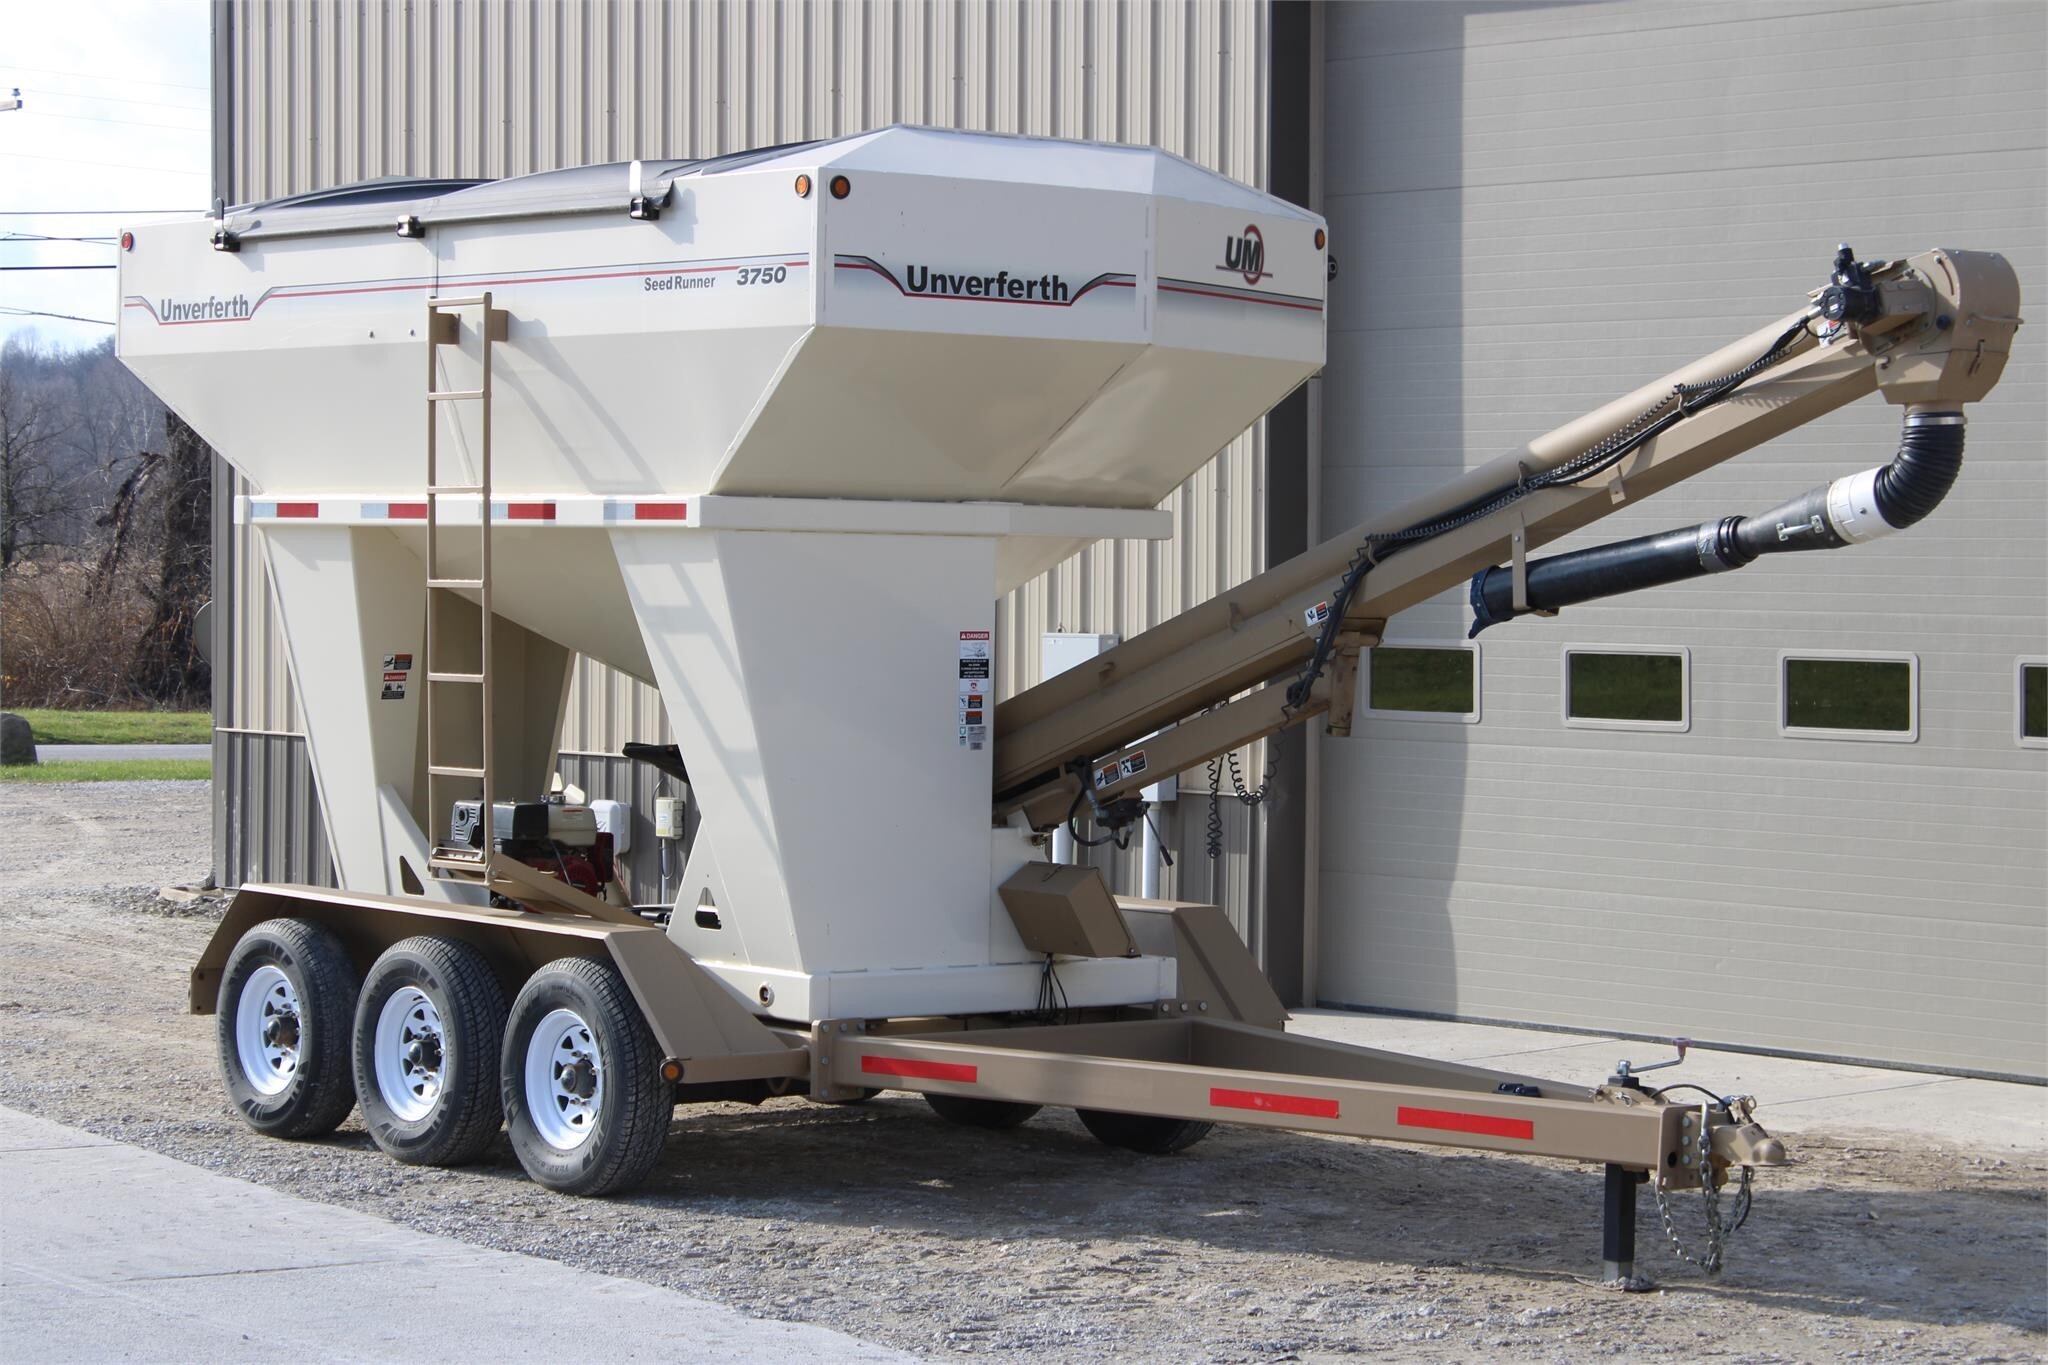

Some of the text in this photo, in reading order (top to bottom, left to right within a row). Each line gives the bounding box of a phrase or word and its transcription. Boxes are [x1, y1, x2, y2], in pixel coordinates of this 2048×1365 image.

[1225, 235, 1261, 272] UM
[737, 266, 787, 286] 3750
[907, 265, 1068, 302] Unverferth
[161, 294, 249, 321] Unverferth
